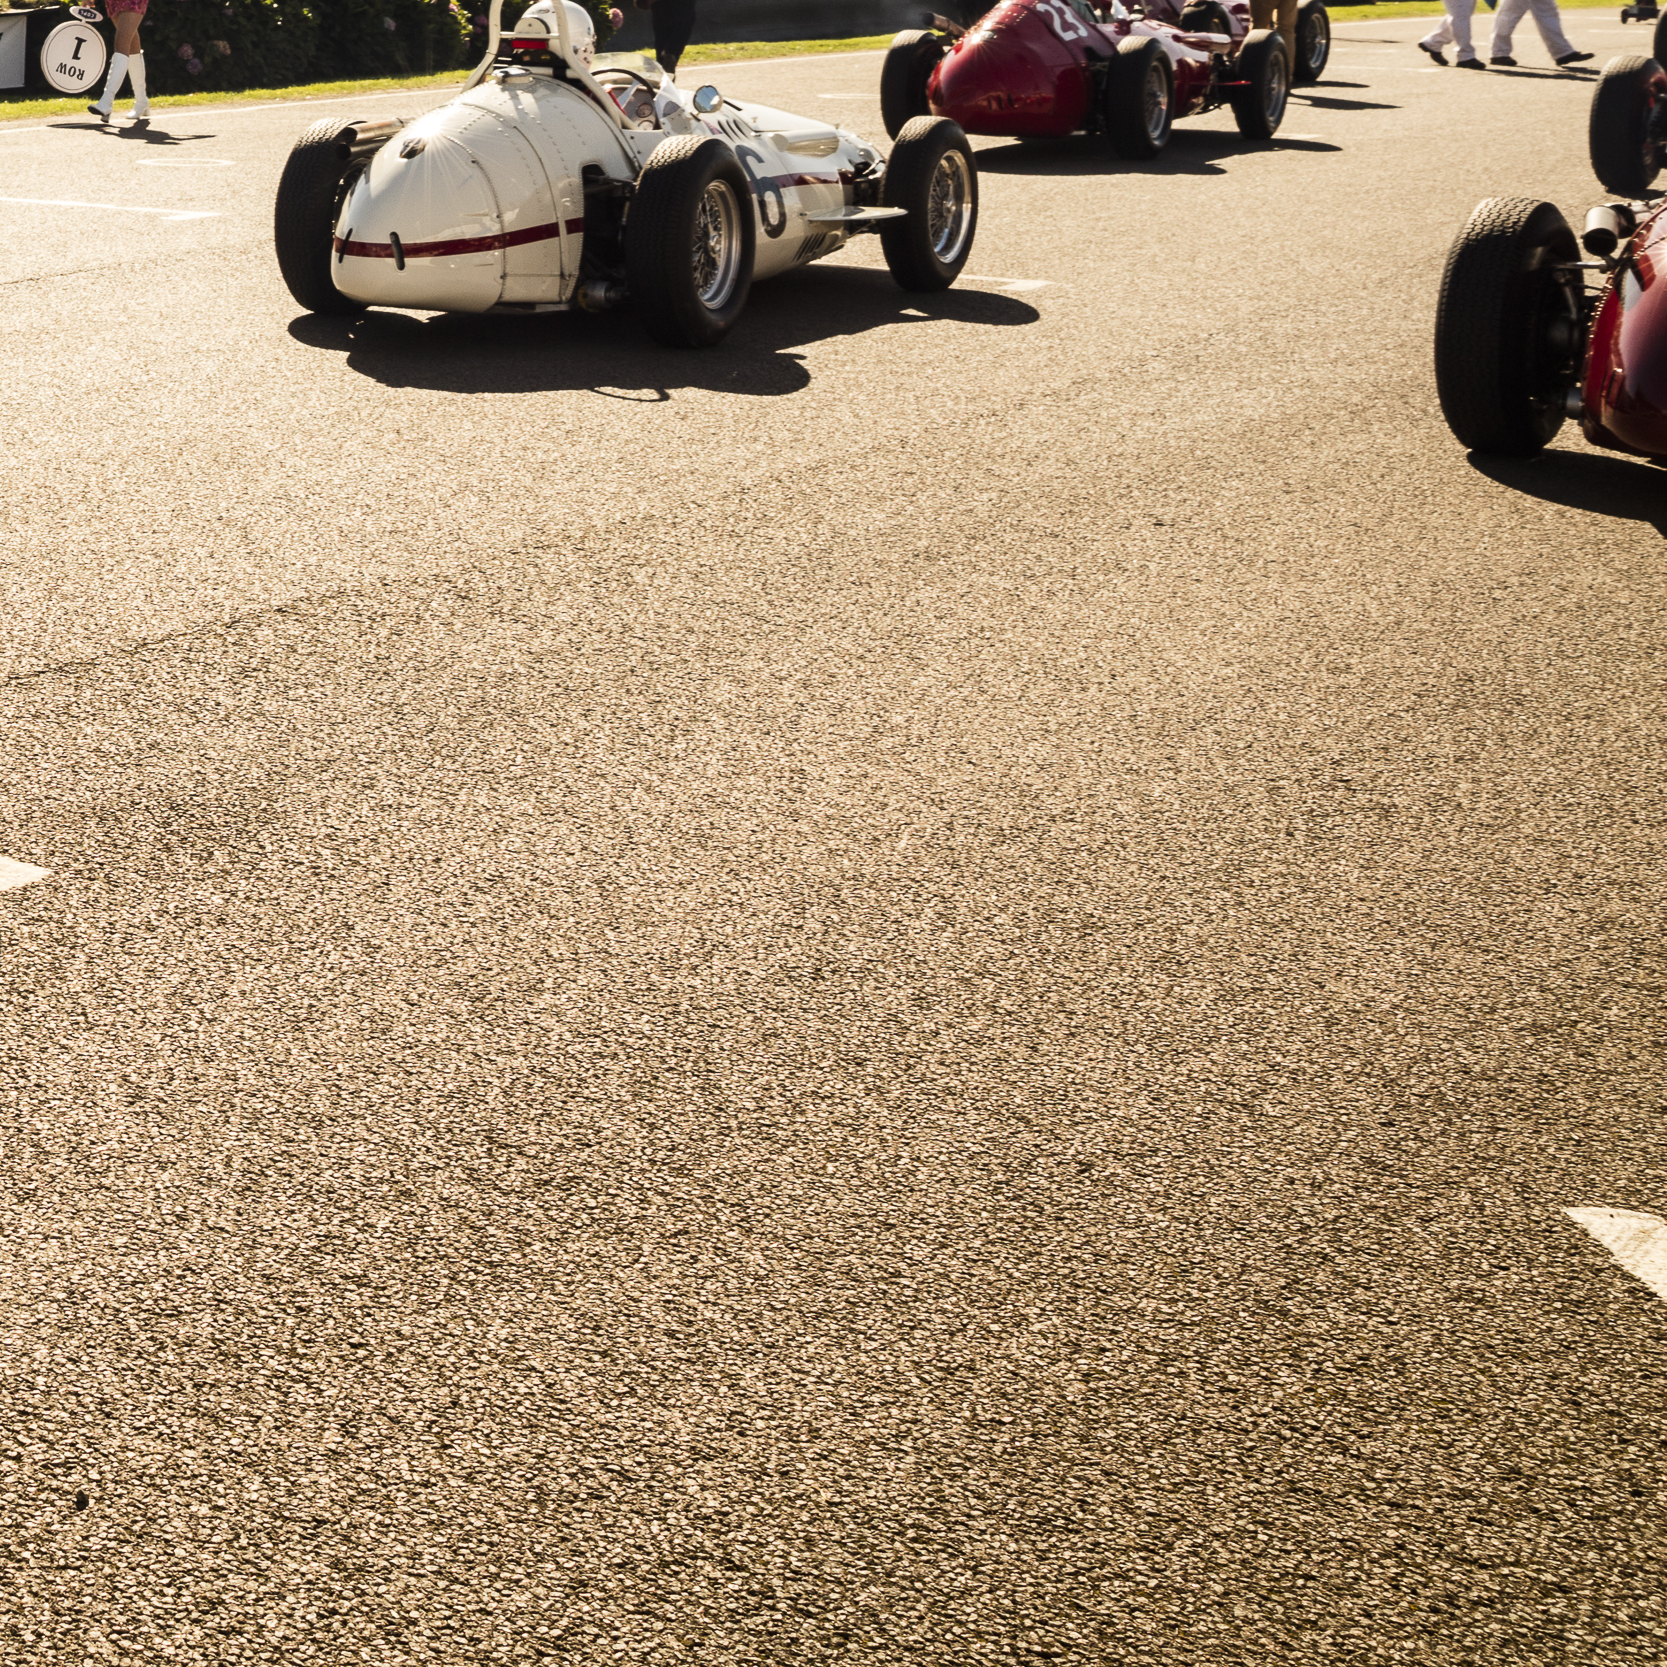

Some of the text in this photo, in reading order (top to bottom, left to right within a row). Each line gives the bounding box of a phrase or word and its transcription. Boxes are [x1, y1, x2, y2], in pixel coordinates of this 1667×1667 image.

[1036, 0, 1088, 41] 23
[72, 36, 87, 61] 1
[55, 62, 86, 81] ROW
[735, 145, 787, 239] 6
